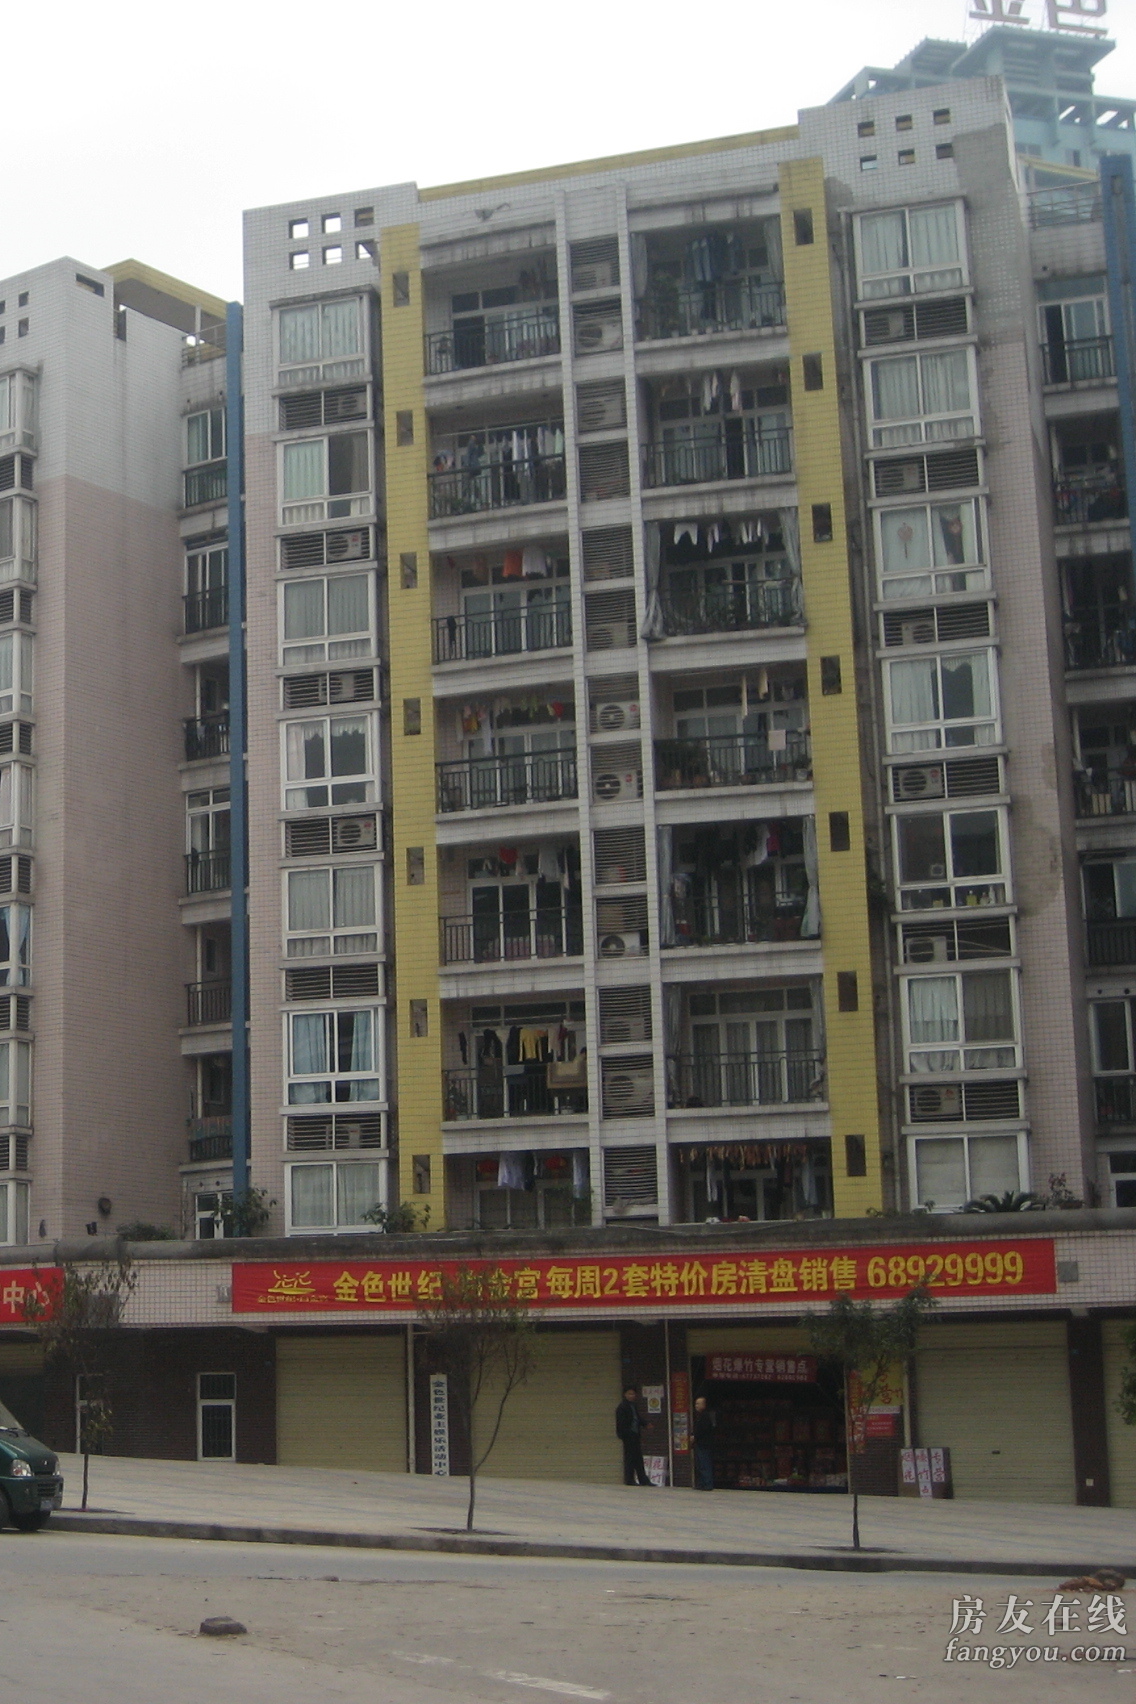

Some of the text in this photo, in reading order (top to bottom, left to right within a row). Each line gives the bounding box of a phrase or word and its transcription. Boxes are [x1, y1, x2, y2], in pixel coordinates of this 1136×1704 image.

[333, 1251, 1024, 1303] 金色世纪·金宫每周2套特价房清盘销售 68929999
